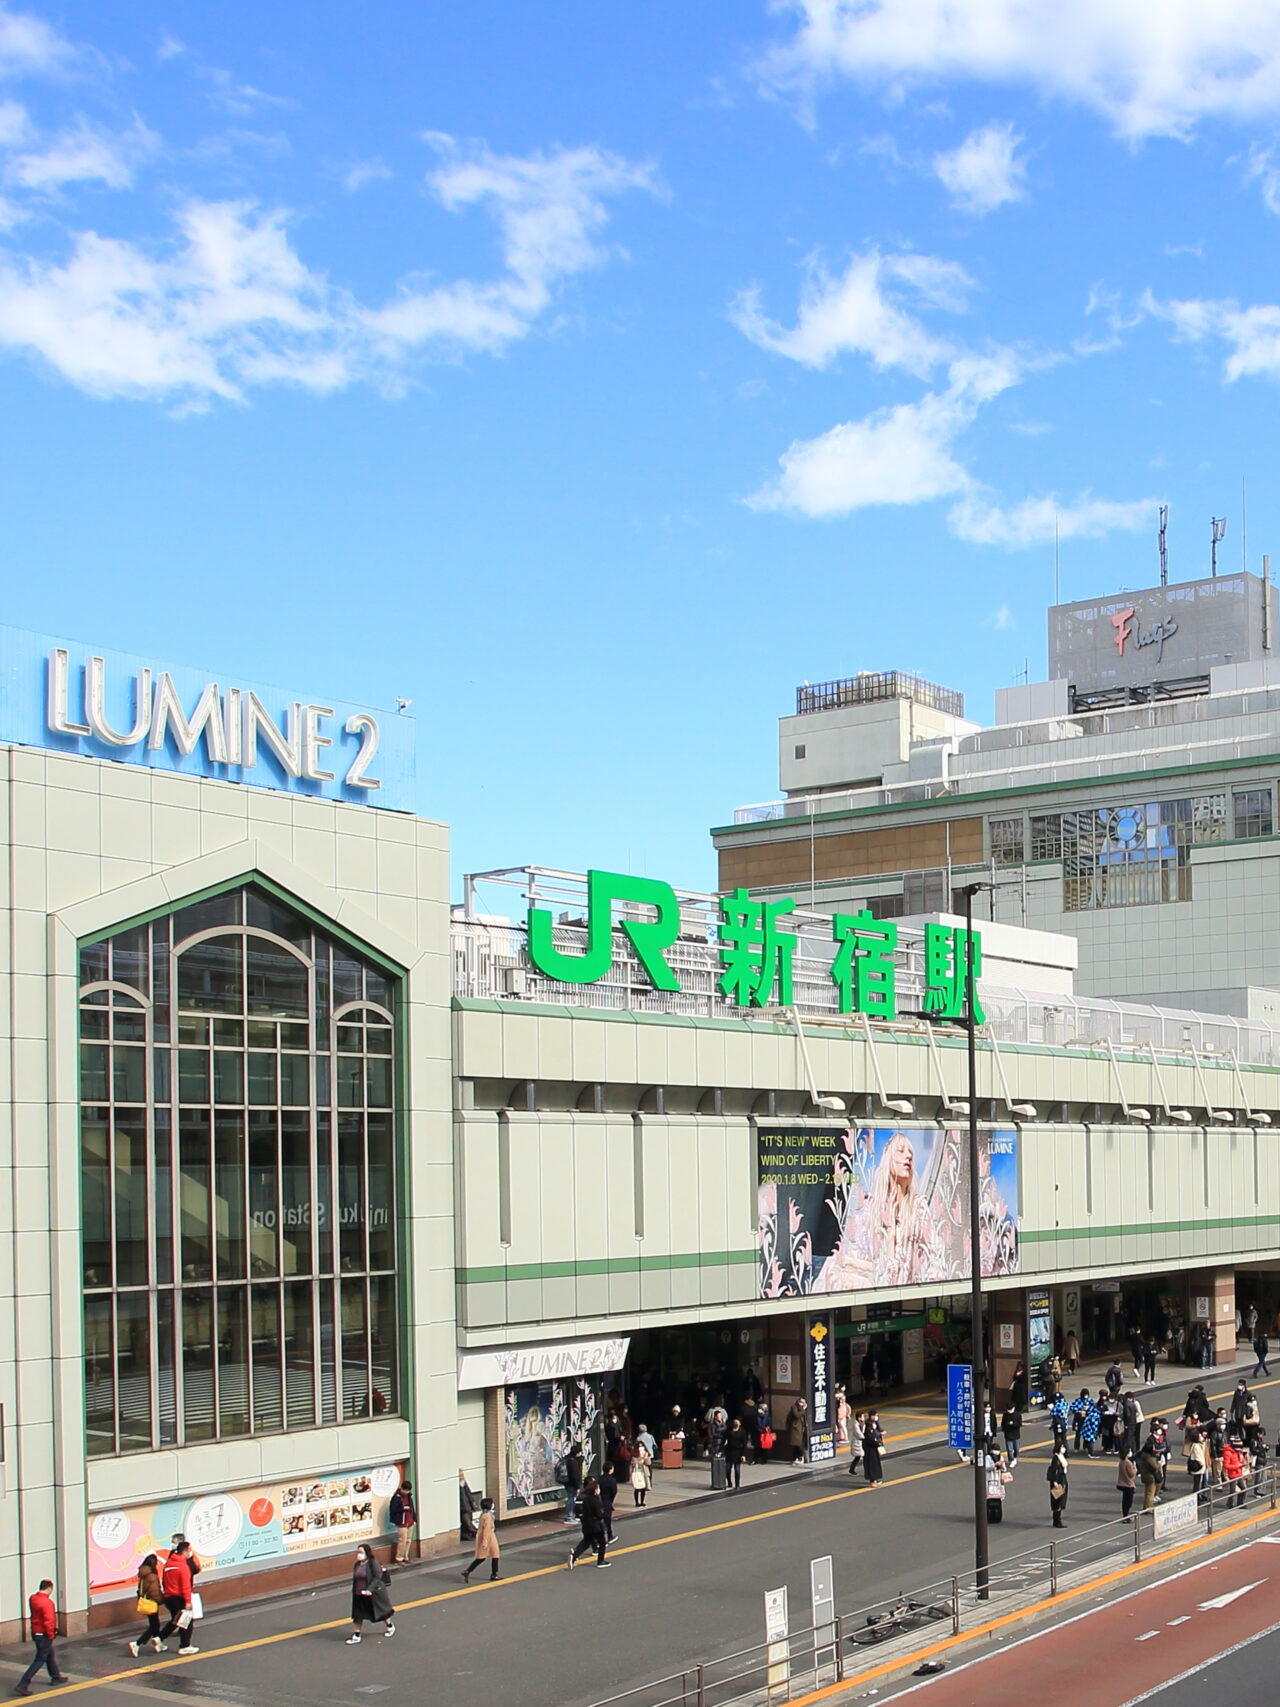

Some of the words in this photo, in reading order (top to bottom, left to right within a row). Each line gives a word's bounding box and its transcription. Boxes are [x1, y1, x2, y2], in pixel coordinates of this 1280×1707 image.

[48, 647, 335, 782] LUMINE
[344, 713, 381, 790] 2
[527, 869, 681, 992] JR
[718, 887, 986, 1025] 新宿駅
[811, 1136, 836, 1147] WEEK
[988, 1142, 1014, 1155] LUMINE
[761, 1155, 785, 1166] WIND
[787, 1155, 799, 1166] OF
[801, 1154, 836, 1166] LIBERTY
[761, 1174, 796, 1185] 2020.1.8
[798, 1174, 818, 1184] WED
[520, 1352, 588, 1378] LUMINE
[590, 1350, 601, 1370] 2
[813, 1343, 827, 1423] 住友不動産
[355, 1530, 373, 1539] FLOOR
[215, 1557, 235, 1566] FLOOR
